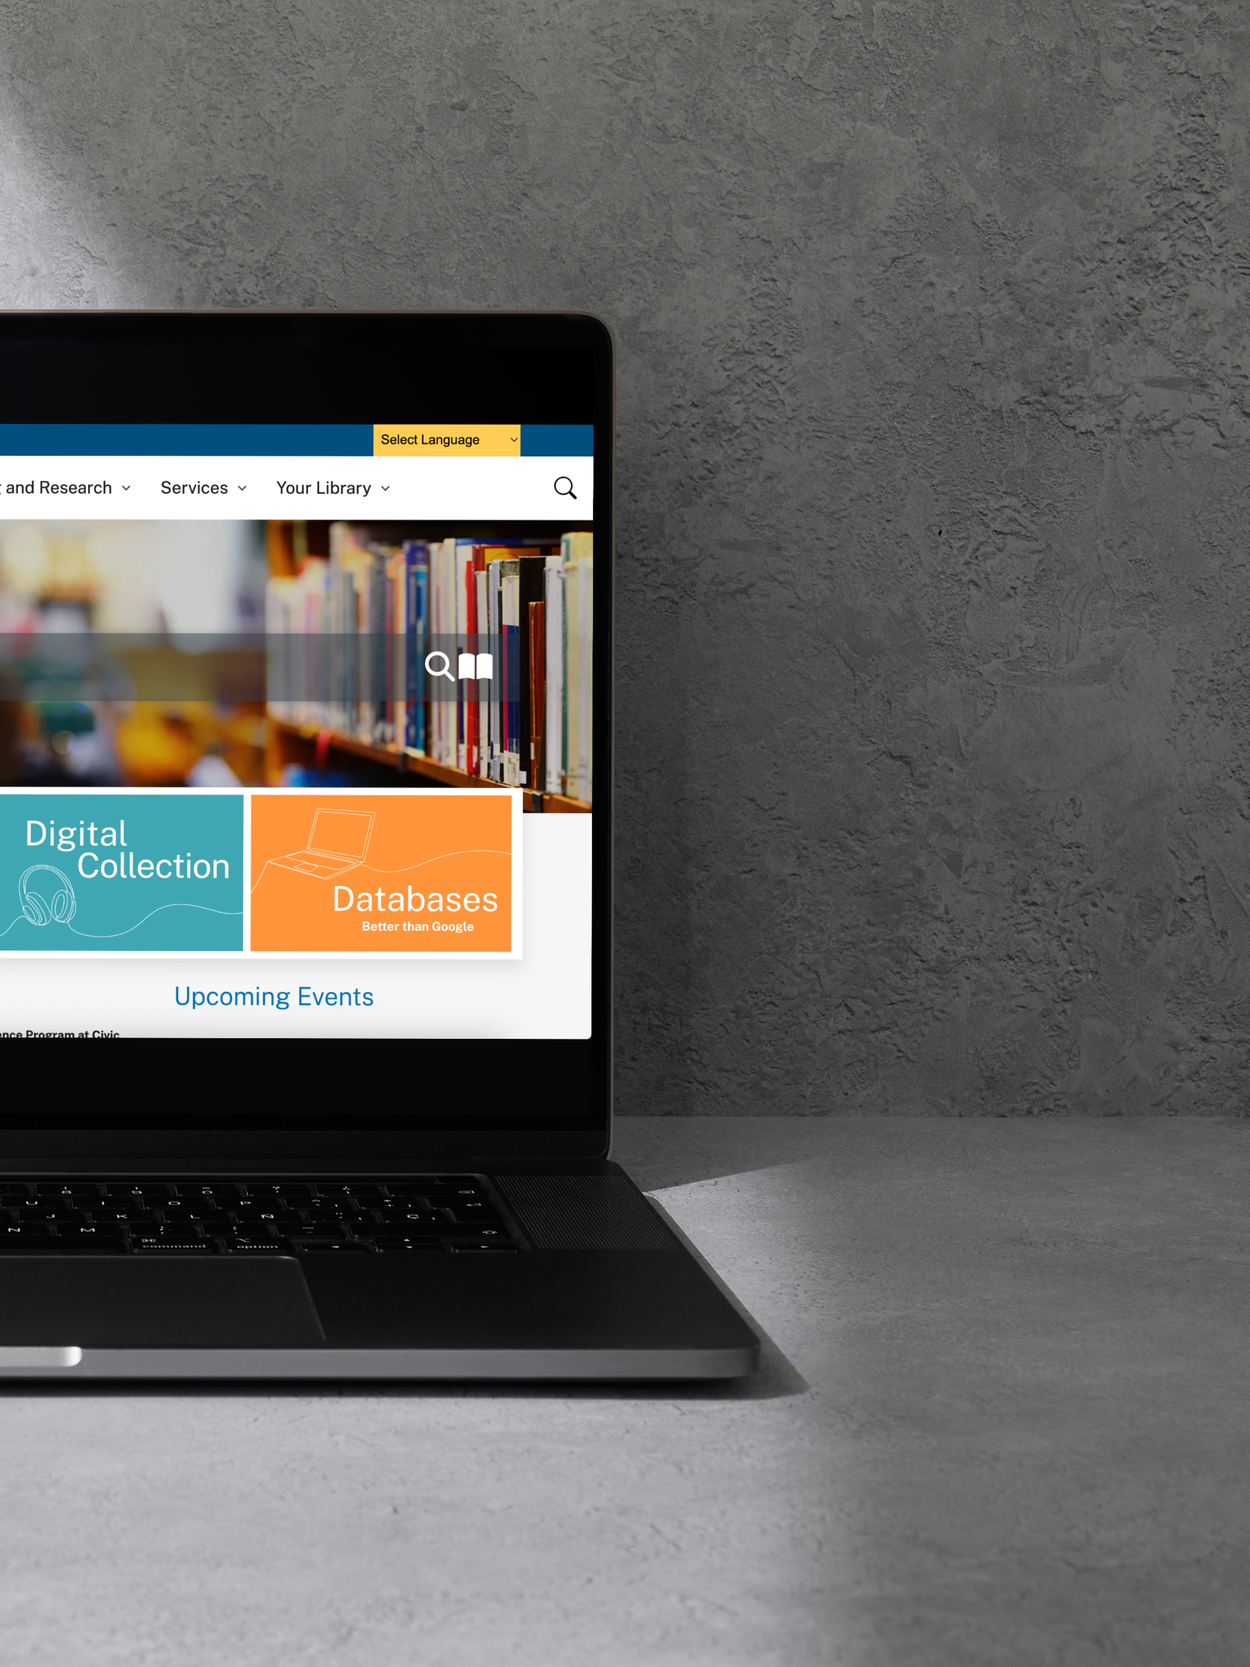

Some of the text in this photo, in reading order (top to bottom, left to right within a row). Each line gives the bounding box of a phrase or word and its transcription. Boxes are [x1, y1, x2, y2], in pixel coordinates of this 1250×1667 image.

[381, 434, 479, 447] Select Language
[6, 481, 34, 494] and
[40, 481, 111, 494] Research
[161, 481, 228, 494] Services
[277, 481, 371, 497] Your Library
[27, 820, 127, 852] Digital
[78, 852, 229, 878] Collection
[334, 885, 497, 912] Databases
[363, 921, 474, 933] Better than Google
[176, 986, 373, 1010] Upcoming Events
